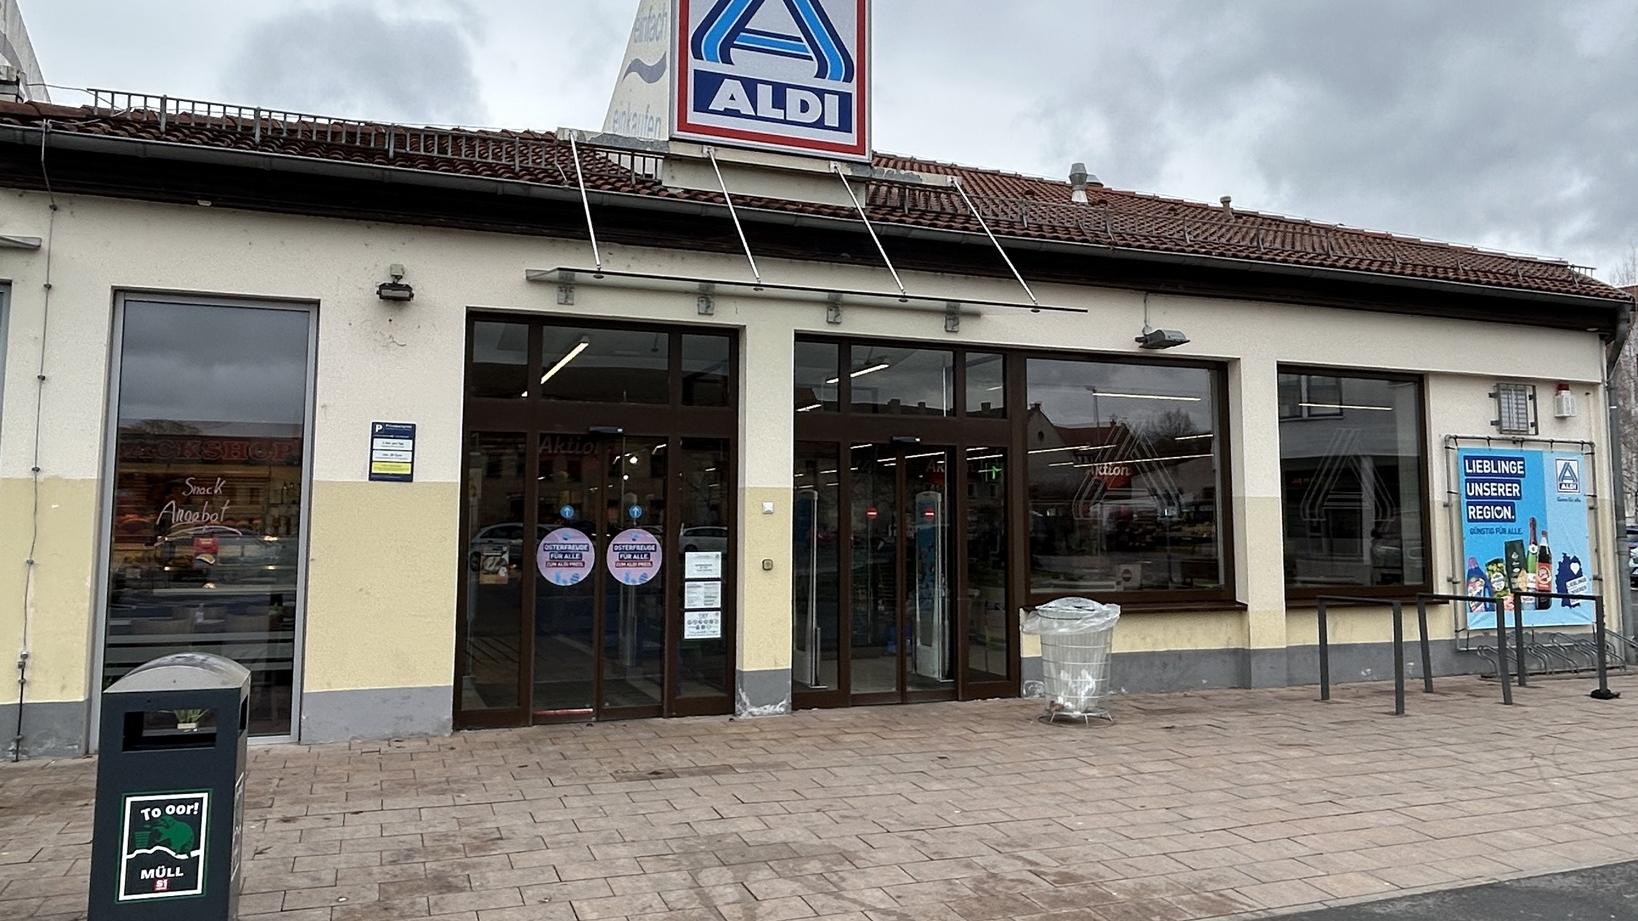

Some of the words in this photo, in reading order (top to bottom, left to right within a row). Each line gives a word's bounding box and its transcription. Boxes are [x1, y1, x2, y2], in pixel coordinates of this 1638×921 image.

[632, 3, 668, 43] einfach
[708, 78, 839, 128] ALDI
[612, 102, 662, 137] einkaufen
[375, 424, 383, 433] P
[1464, 459, 1525, 475] LIEBLINGE
[181, 476, 227, 497] Snack
[1466, 482, 1521, 497] UNSERER
[156, 499, 231, 525] Angebot
[1467, 505, 1515, 520] REGION.
[1469, 526, 1495, 535] GÜNSTIG
[1495, 527, 1507, 535] FÜR
[140, 806, 162, 821] To
[165, 802, 200, 816] oor!
[140, 865, 184, 880] MÜLL
